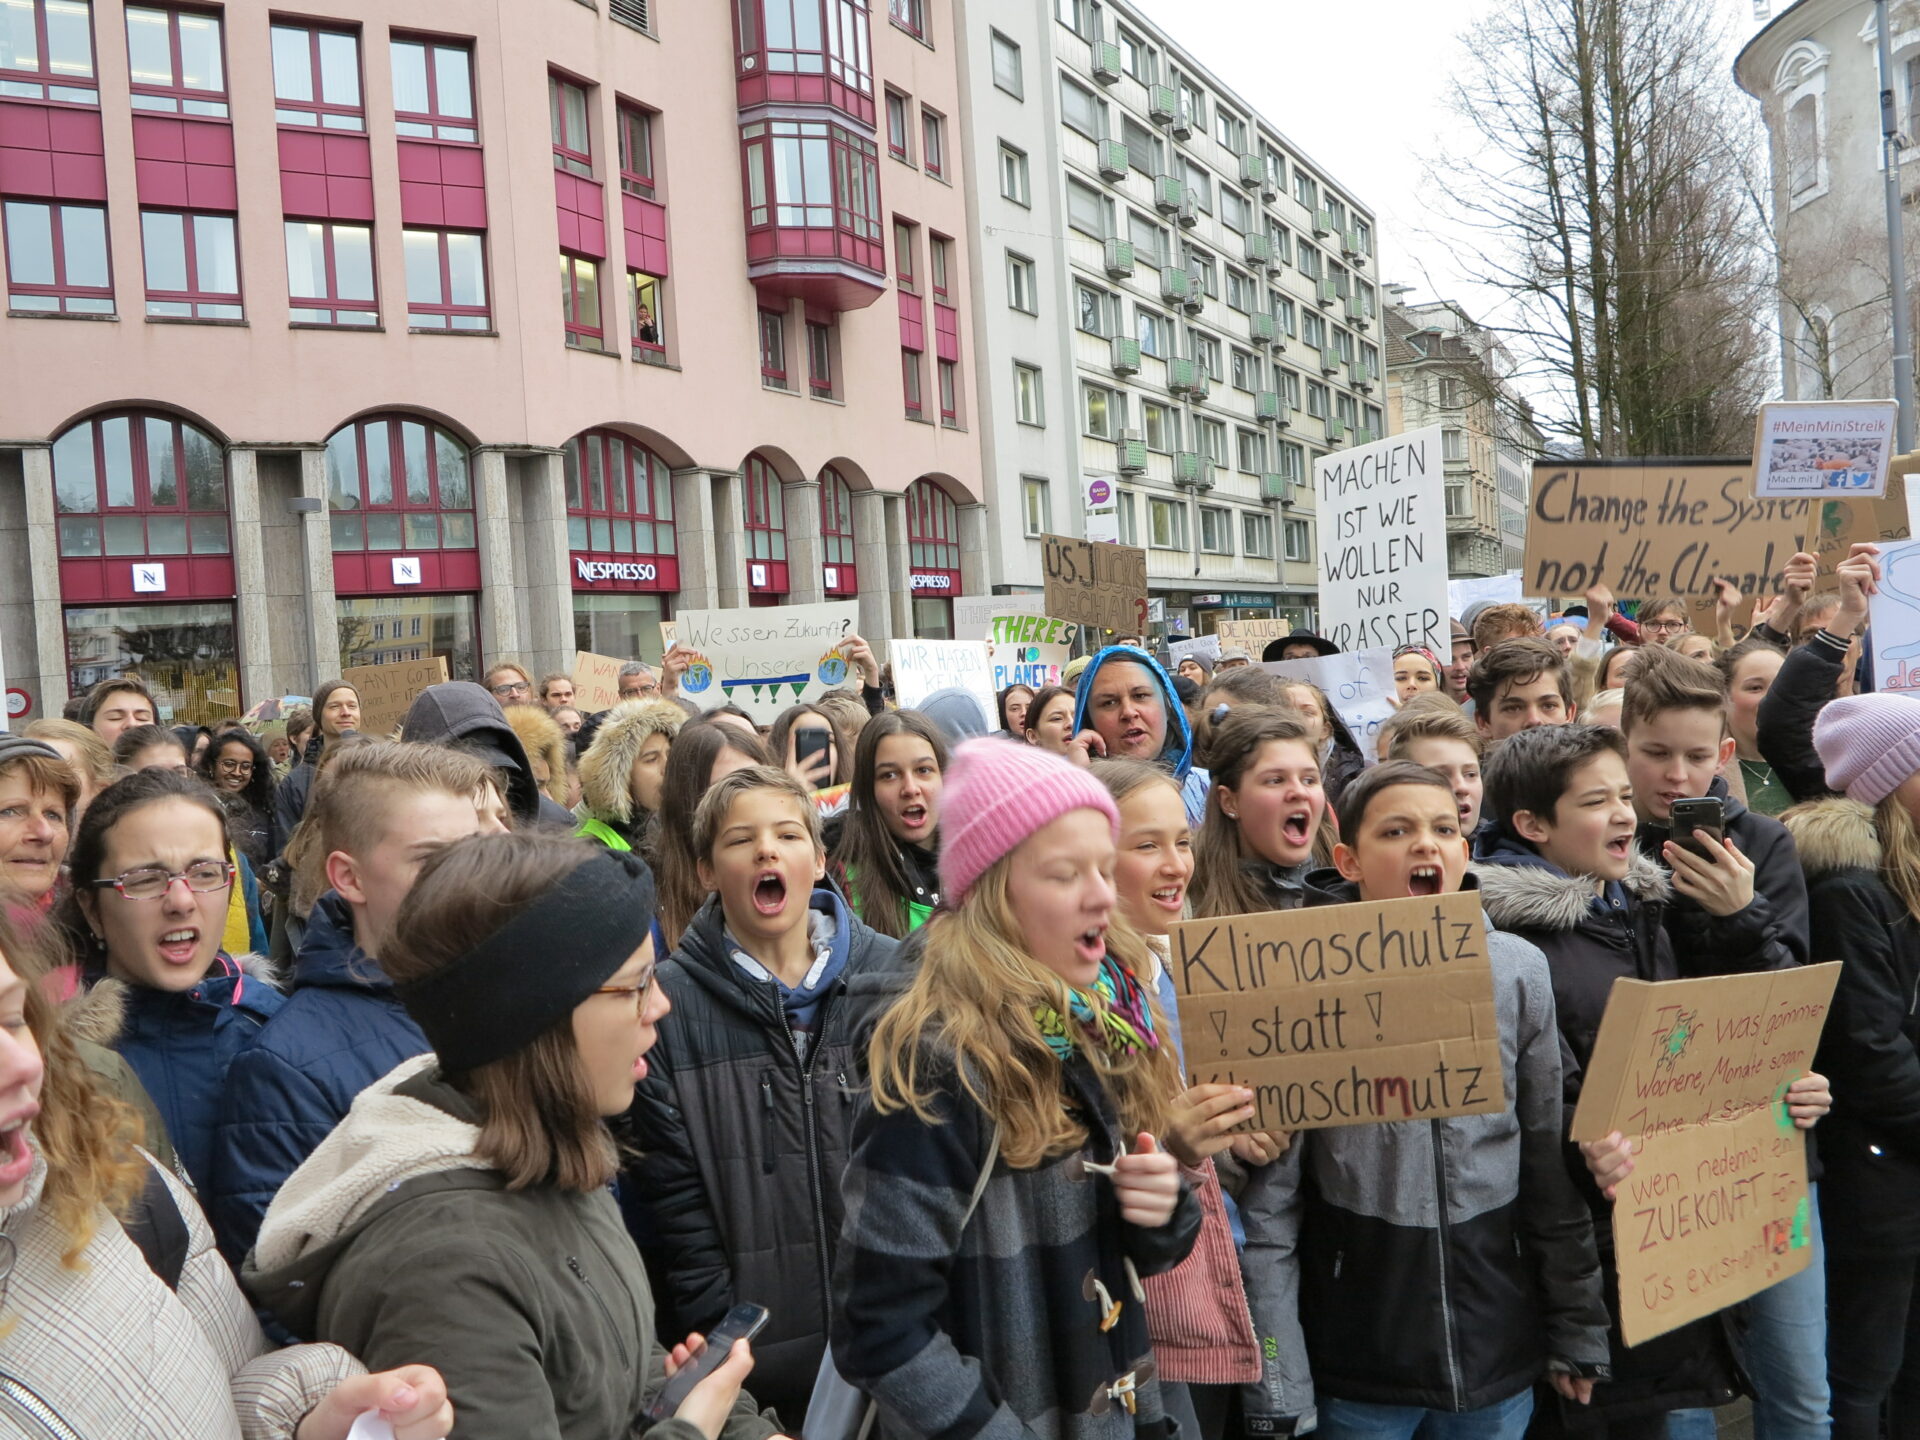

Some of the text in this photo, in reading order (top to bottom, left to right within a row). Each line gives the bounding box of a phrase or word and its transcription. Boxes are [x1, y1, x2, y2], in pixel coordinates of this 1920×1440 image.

[1772, 420, 1886, 433] #MeinMiniStreik
[1324, 440, 1425, 502] MACHEN
[1771, 472, 1796, 484] Mach
[1798, 472, 1814, 483] mit
[1337, 494, 1418, 541] IST WIE
[1535, 471, 1648, 535] Change
[1657, 477, 1709, 525] the
[574, 557, 656, 582] NESPRESSO
[1324, 532, 1424, 582] WOLLEN
[1535, 541, 1609, 593] not
[1616, 539, 1661, 595] the
[1358, 582, 1402, 609] NUR
[687, 615, 778, 647] Wessen
[992, 615, 1076, 646] THERE'S
[593, 659, 619, 678] WAN
[725, 656, 806, 679] Unsere
[899, 645, 932, 671] WIR
[995, 664, 1047, 690] PLANET
[1340, 667, 1371, 699] of
[1179, 905, 1479, 995] Klimaschutz
[1247, 998, 1347, 1058] statt
[1191, 1061, 1489, 1136] imaschmutz
[1264, 1337, 1279, 1359] 932
